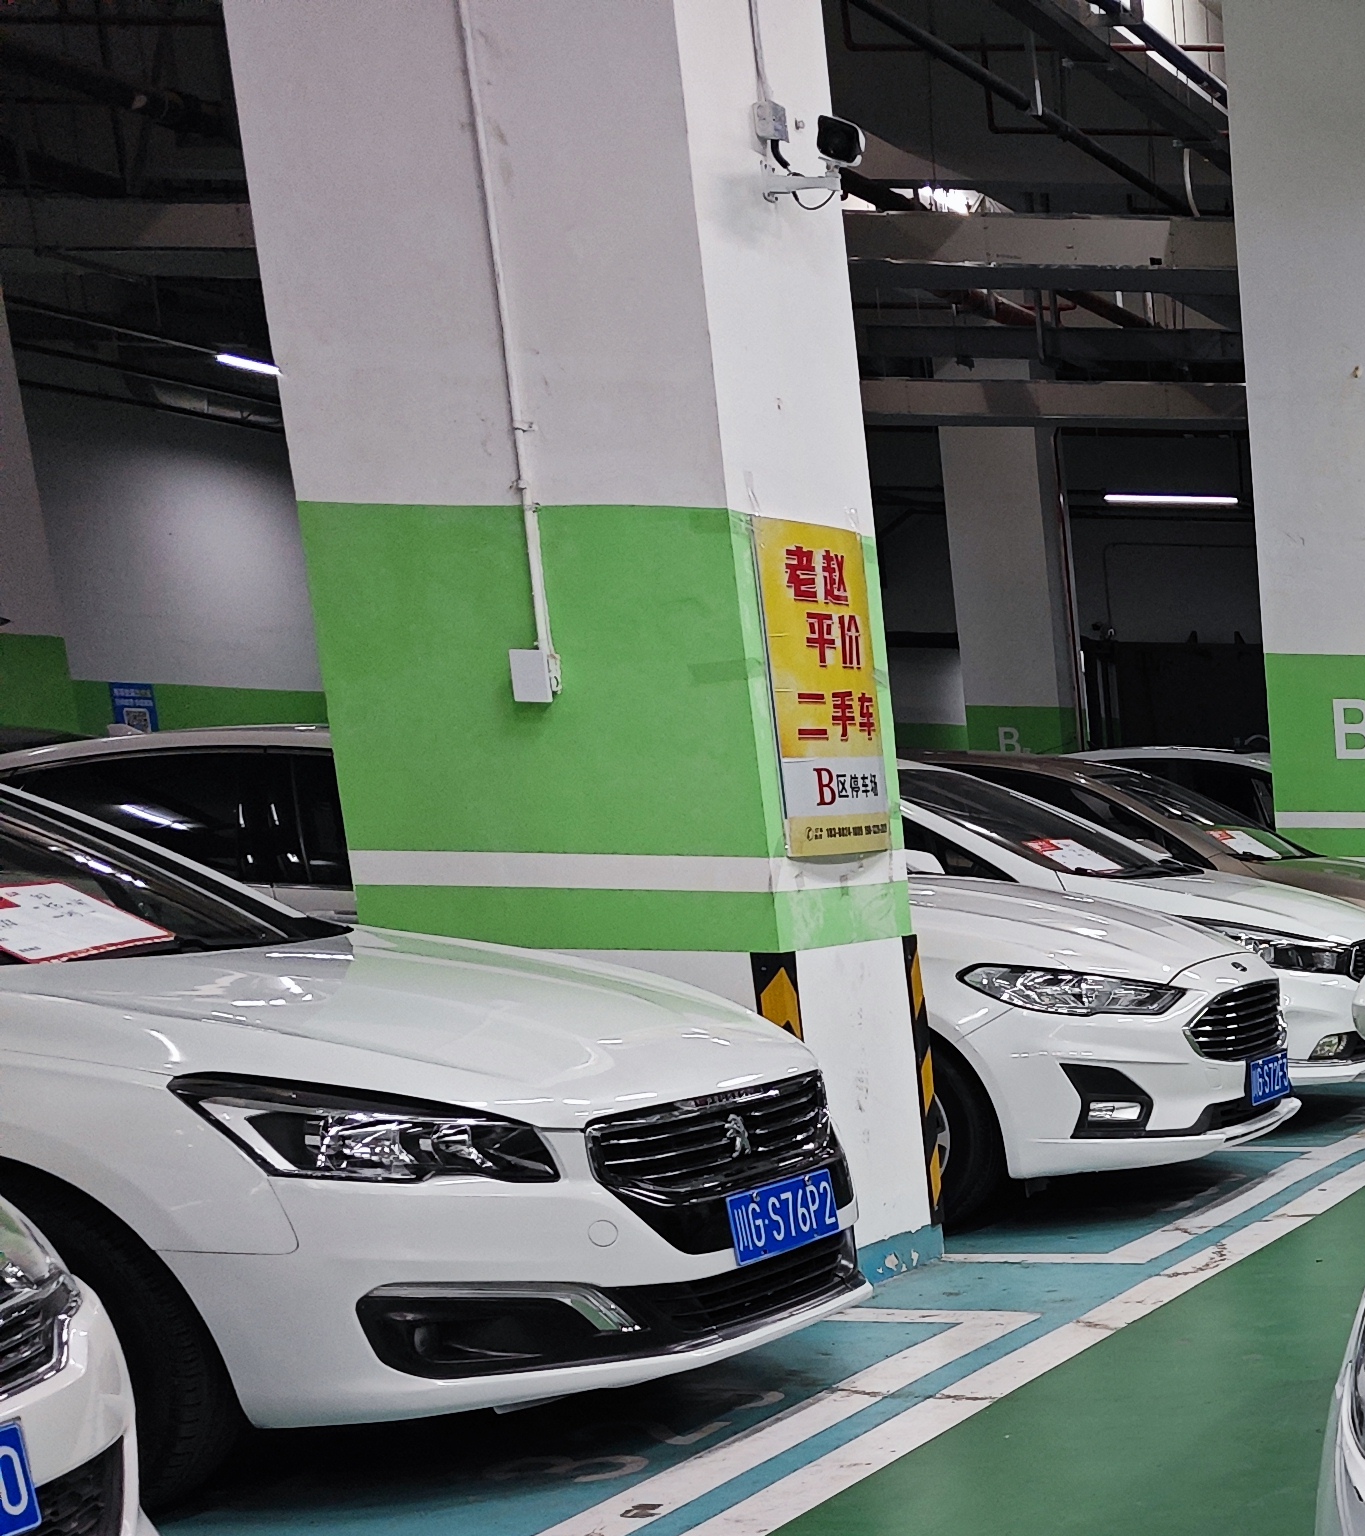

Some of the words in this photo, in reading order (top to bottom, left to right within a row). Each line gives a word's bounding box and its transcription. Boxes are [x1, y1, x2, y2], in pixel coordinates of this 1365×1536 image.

[785, 545, 849, 606] 老赵
[806, 611, 862, 670] 平价
[797, 690, 876, 742] 二手车
[813, 767, 879, 806] B区停车场
